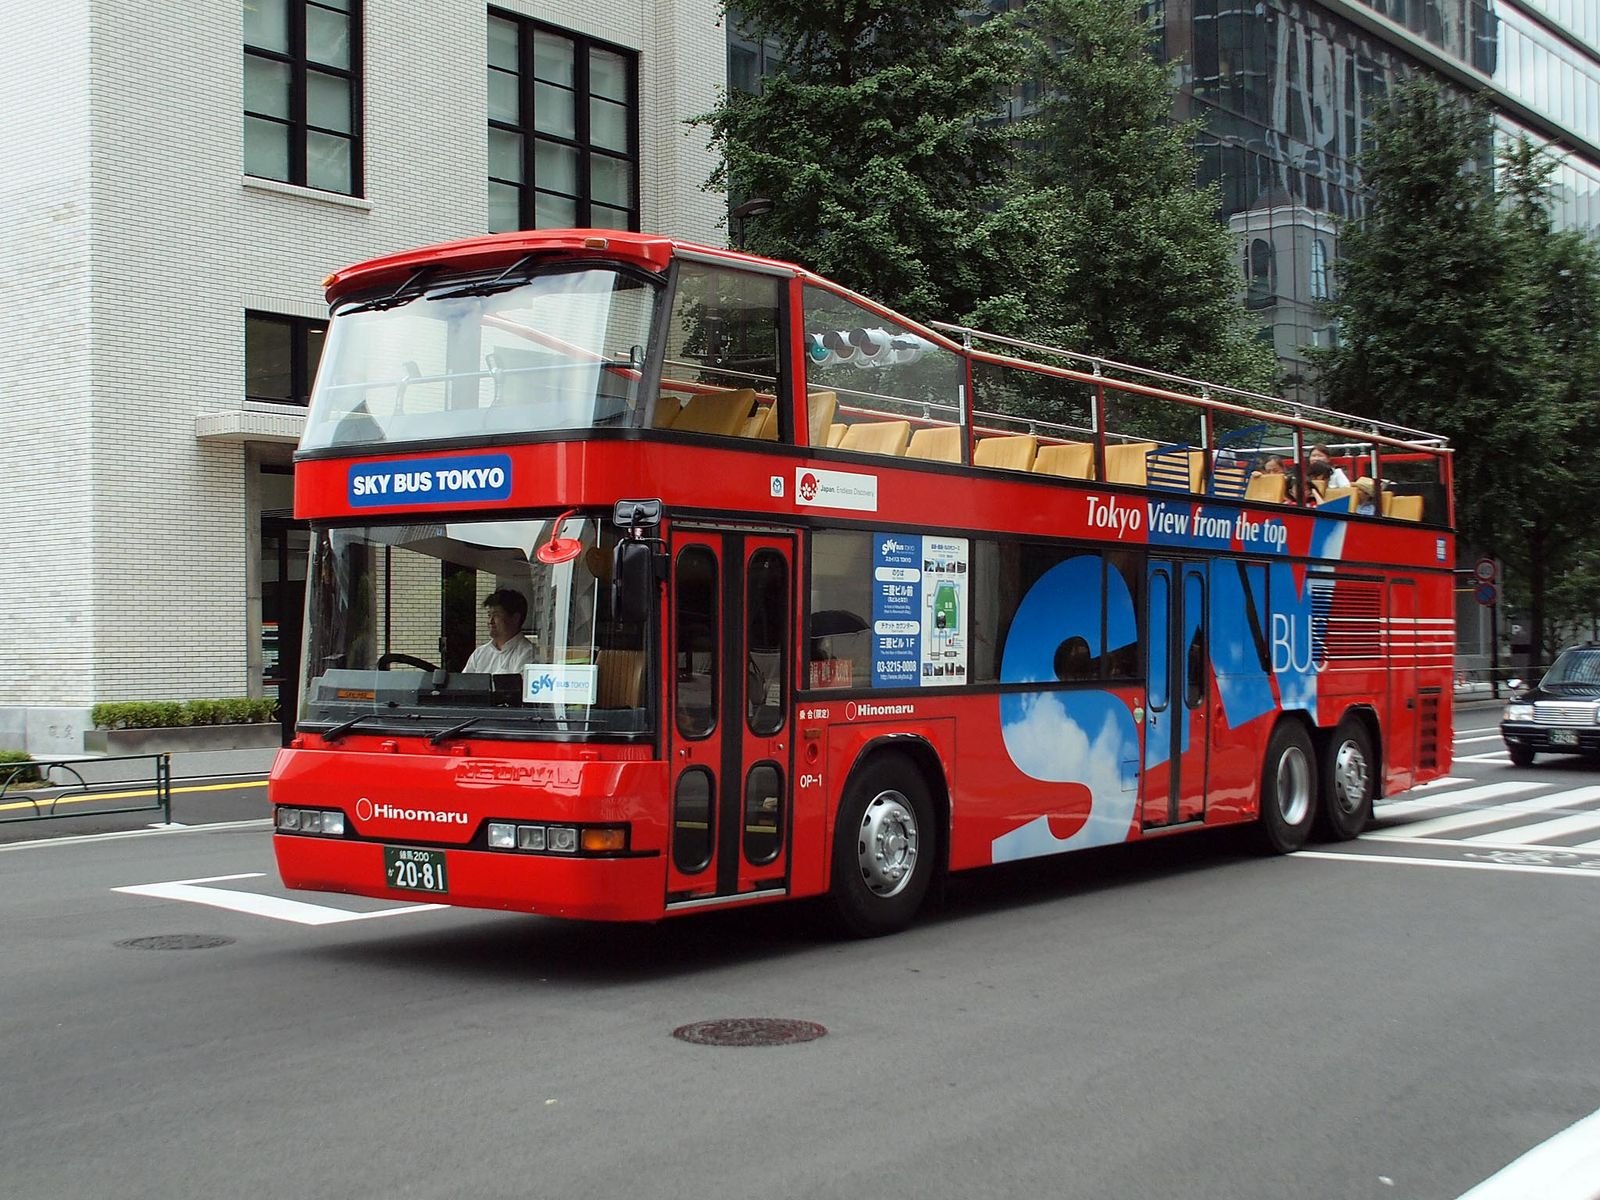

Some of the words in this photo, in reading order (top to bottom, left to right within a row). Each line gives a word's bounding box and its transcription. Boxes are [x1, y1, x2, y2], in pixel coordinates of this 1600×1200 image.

[353, 474, 391, 496] SKY
[393, 472, 433, 493] BUS
[436, 468, 504, 491] TOKYO
[1086, 497, 1141, 540] Tokyo
[1147, 502, 1188, 536] View
[1193, 506, 1231, 540] from
[1236, 513, 1259, 543] the
[1263, 519, 1287, 553] top
[1511, 624, 1522, 635] P
[1272, 613, 1328, 673] BUS
[530, 673, 557, 695] SKY
[857, 703, 914, 716] Hinomaru
[800, 774, 822, 788] OP-1
[373, 804, 468, 824] Hinomaru
